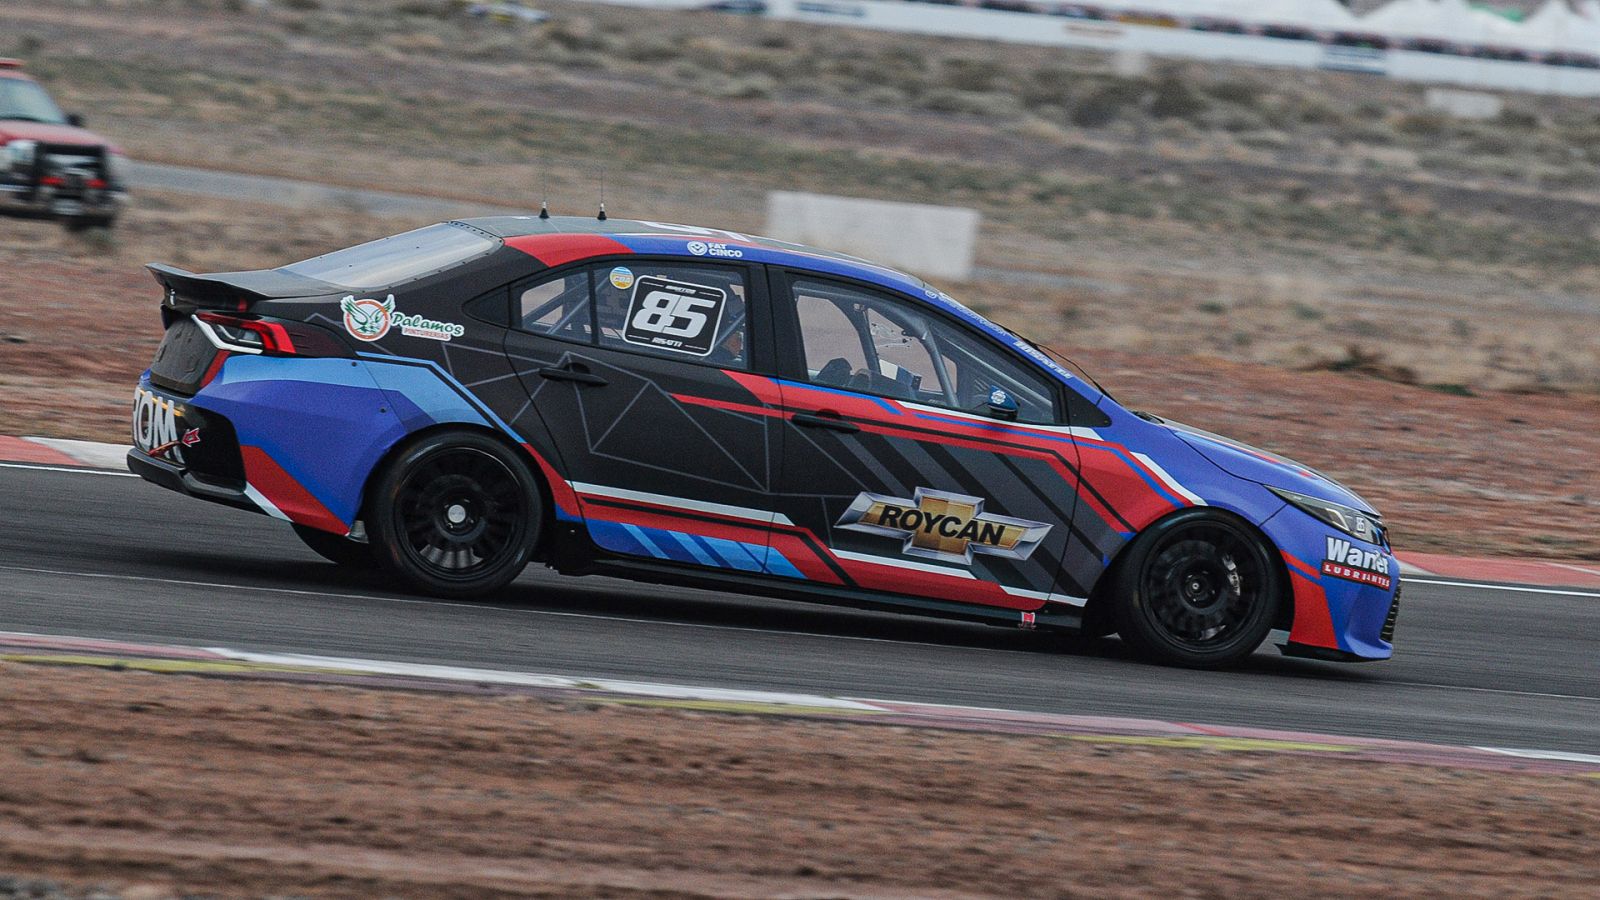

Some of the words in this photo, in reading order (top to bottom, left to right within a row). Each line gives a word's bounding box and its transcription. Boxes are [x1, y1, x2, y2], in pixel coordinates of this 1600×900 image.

[708, 248, 743, 258] CINCO
[392, 313, 462, 335] Palamos
[632, 290, 716, 338] 85
[878, 504, 1006, 545] ROYCAN
